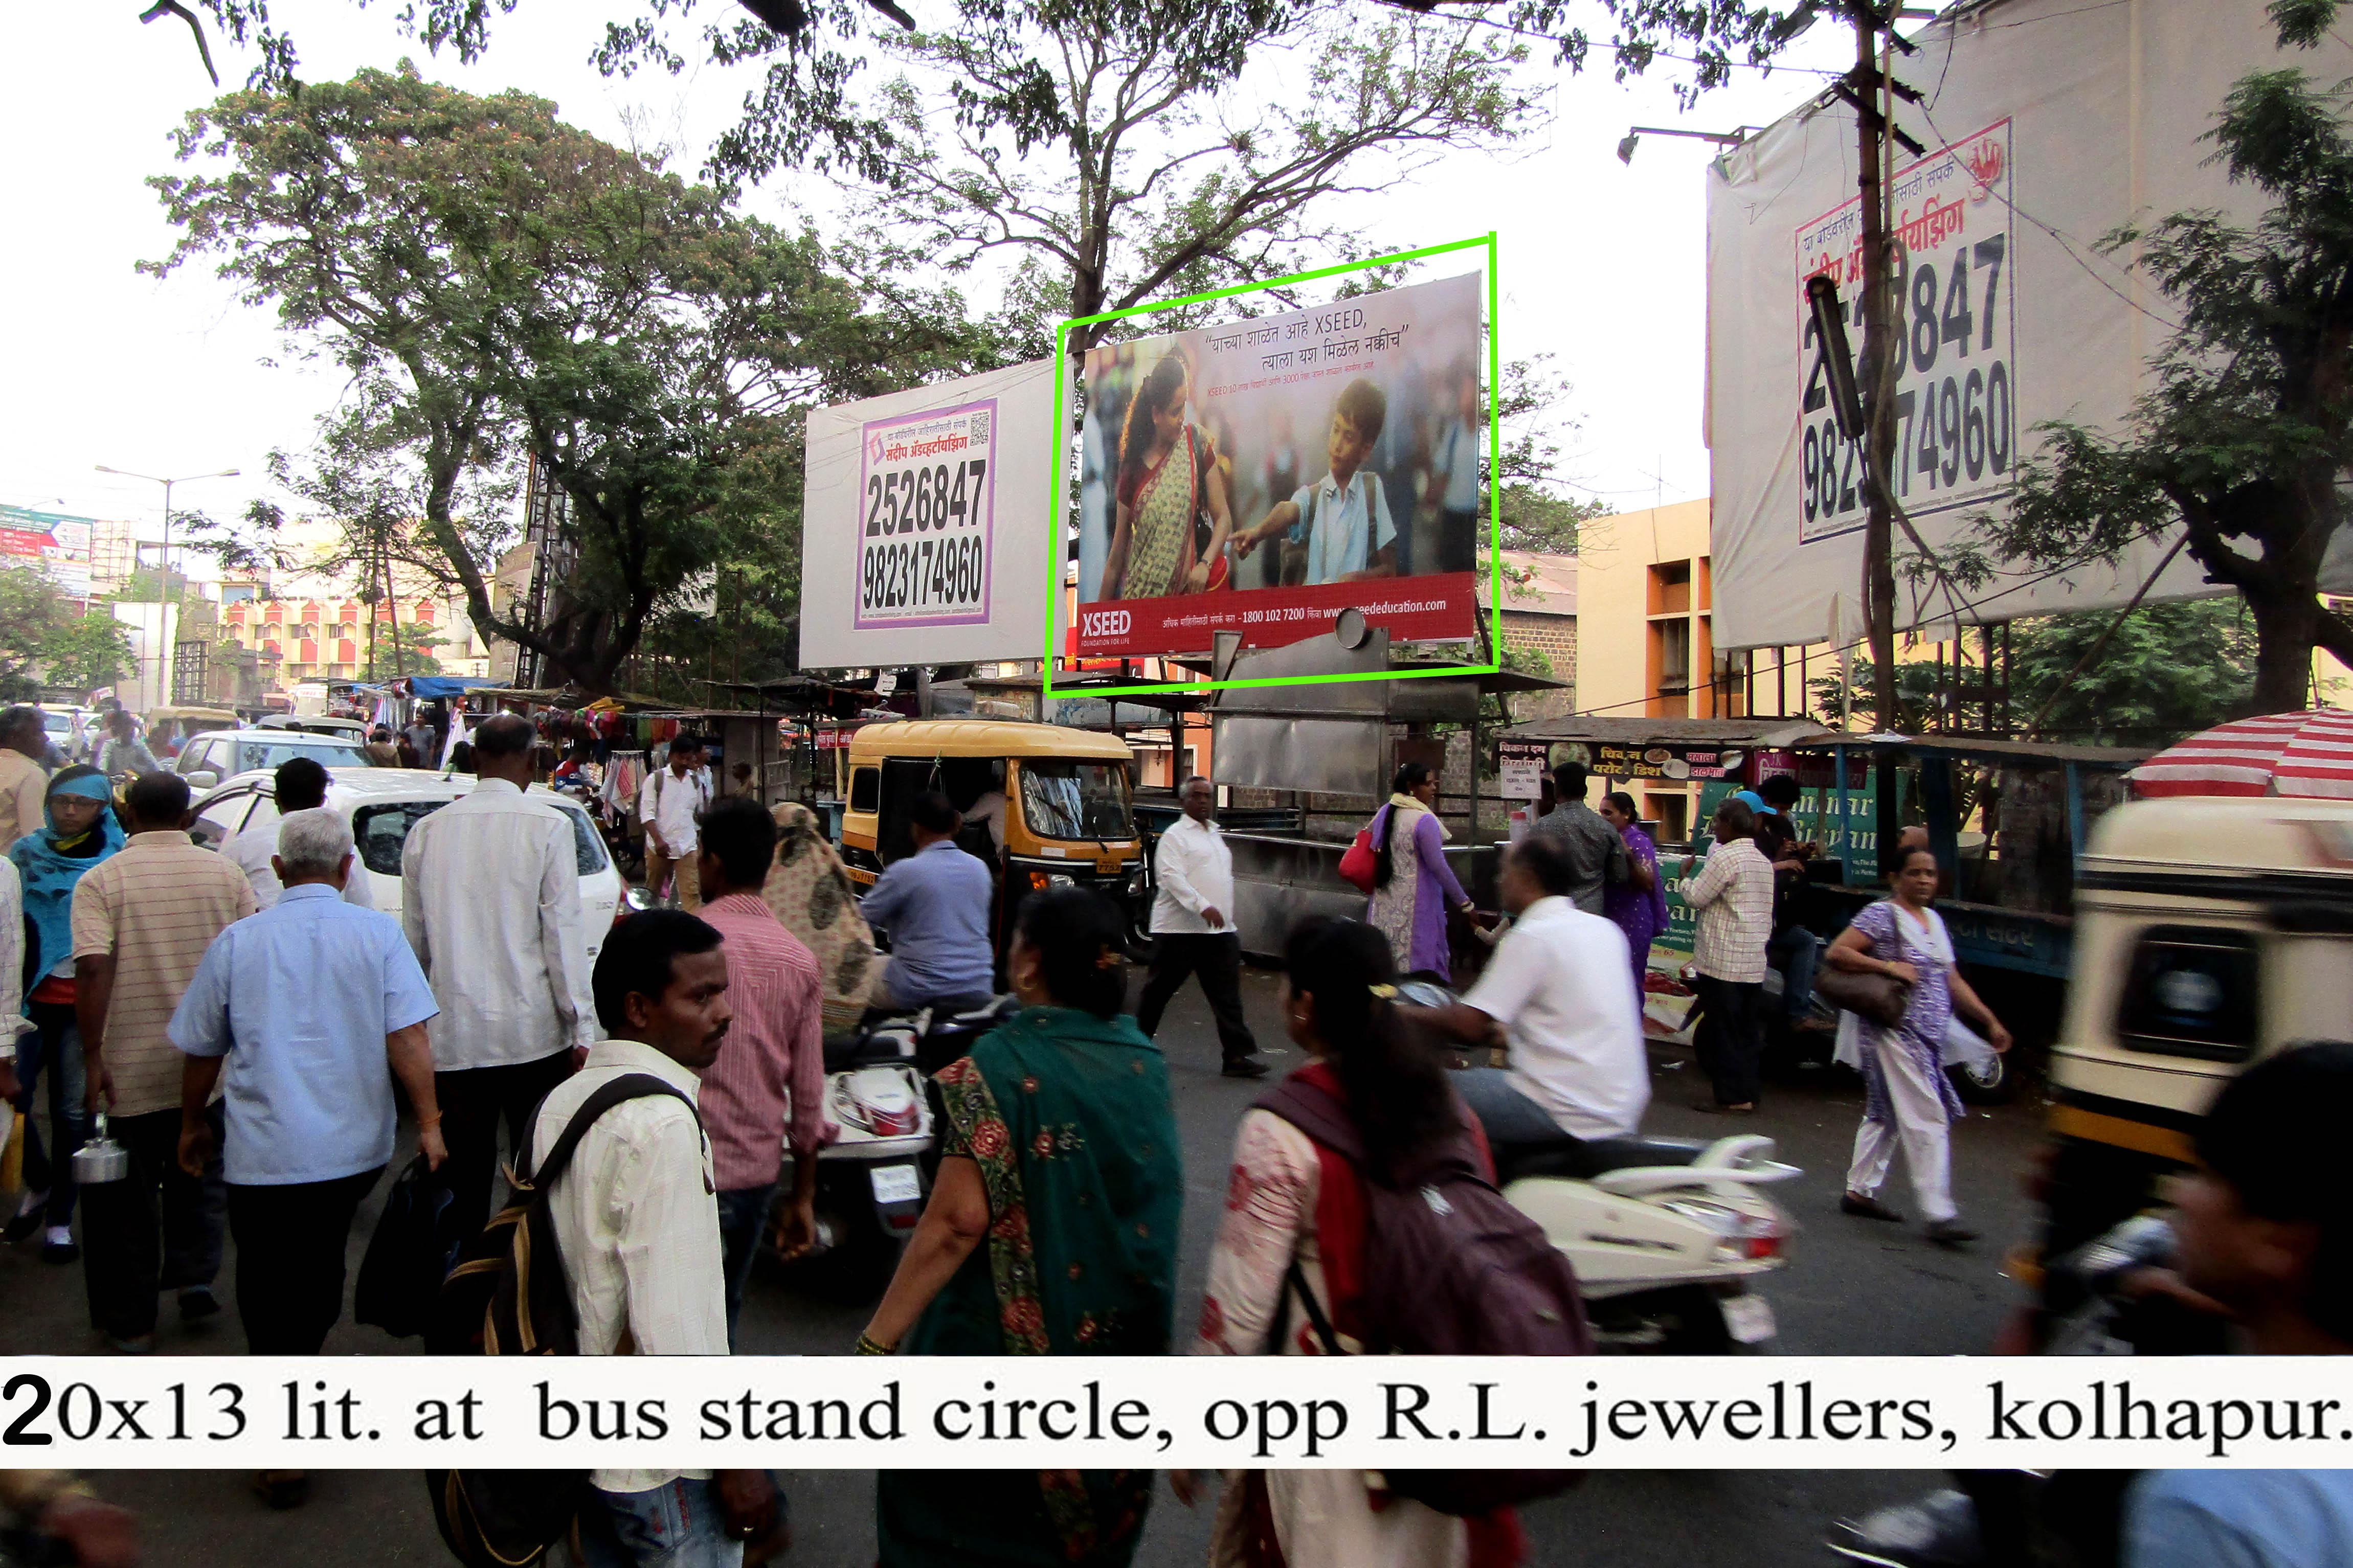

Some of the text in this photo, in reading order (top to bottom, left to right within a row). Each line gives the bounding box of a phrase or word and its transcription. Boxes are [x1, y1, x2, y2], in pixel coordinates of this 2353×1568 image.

[1926, 156, 1955, 188] संपर्क
[1248, 322, 1279, 347] शाळेत
[1286, 314, 1308, 339] आहे
[1315, 308, 1367, 335] XSEED,
[1262, 352, 1293, 372] त्याला
[1299, 347, 1317, 365] यश
[1323, 335, 1359, 361] मिळेल
[1207, 386, 1227, 398] XSEED
[1229, 384, 1237, 393] 10
[1269, 376, 1281, 386] आणि
[1283, 374, 1299, 384] 3000
[918, 421, 952, 436] जाहिरातीसाठी
[953, 418, 967, 430] संपर्क
[886, 443, 908, 461] संदीप
[866, 459, 987, 537] 2526847
[864, 535, 982, 609] 9823174960
[1082, 610, 1132, 638] XSEED
[1162, 617, 1179, 629] अधिक
[1180, 616, 1208, 628] माहितीसाठी
[1210, 612, 1223, 624] संपर्क
[1225, 615, 1235, 623] करा
[1266, 609, 1281, 621] 102
[1283, 608, 1304, 620] 7200
[1306, 607, 1322, 619] किंवा
[1499, 741, 1547, 754] चिकन दम
[1686, 753, 1717, 763] मसाला
[1633, 763, 1662, 777] डिश
